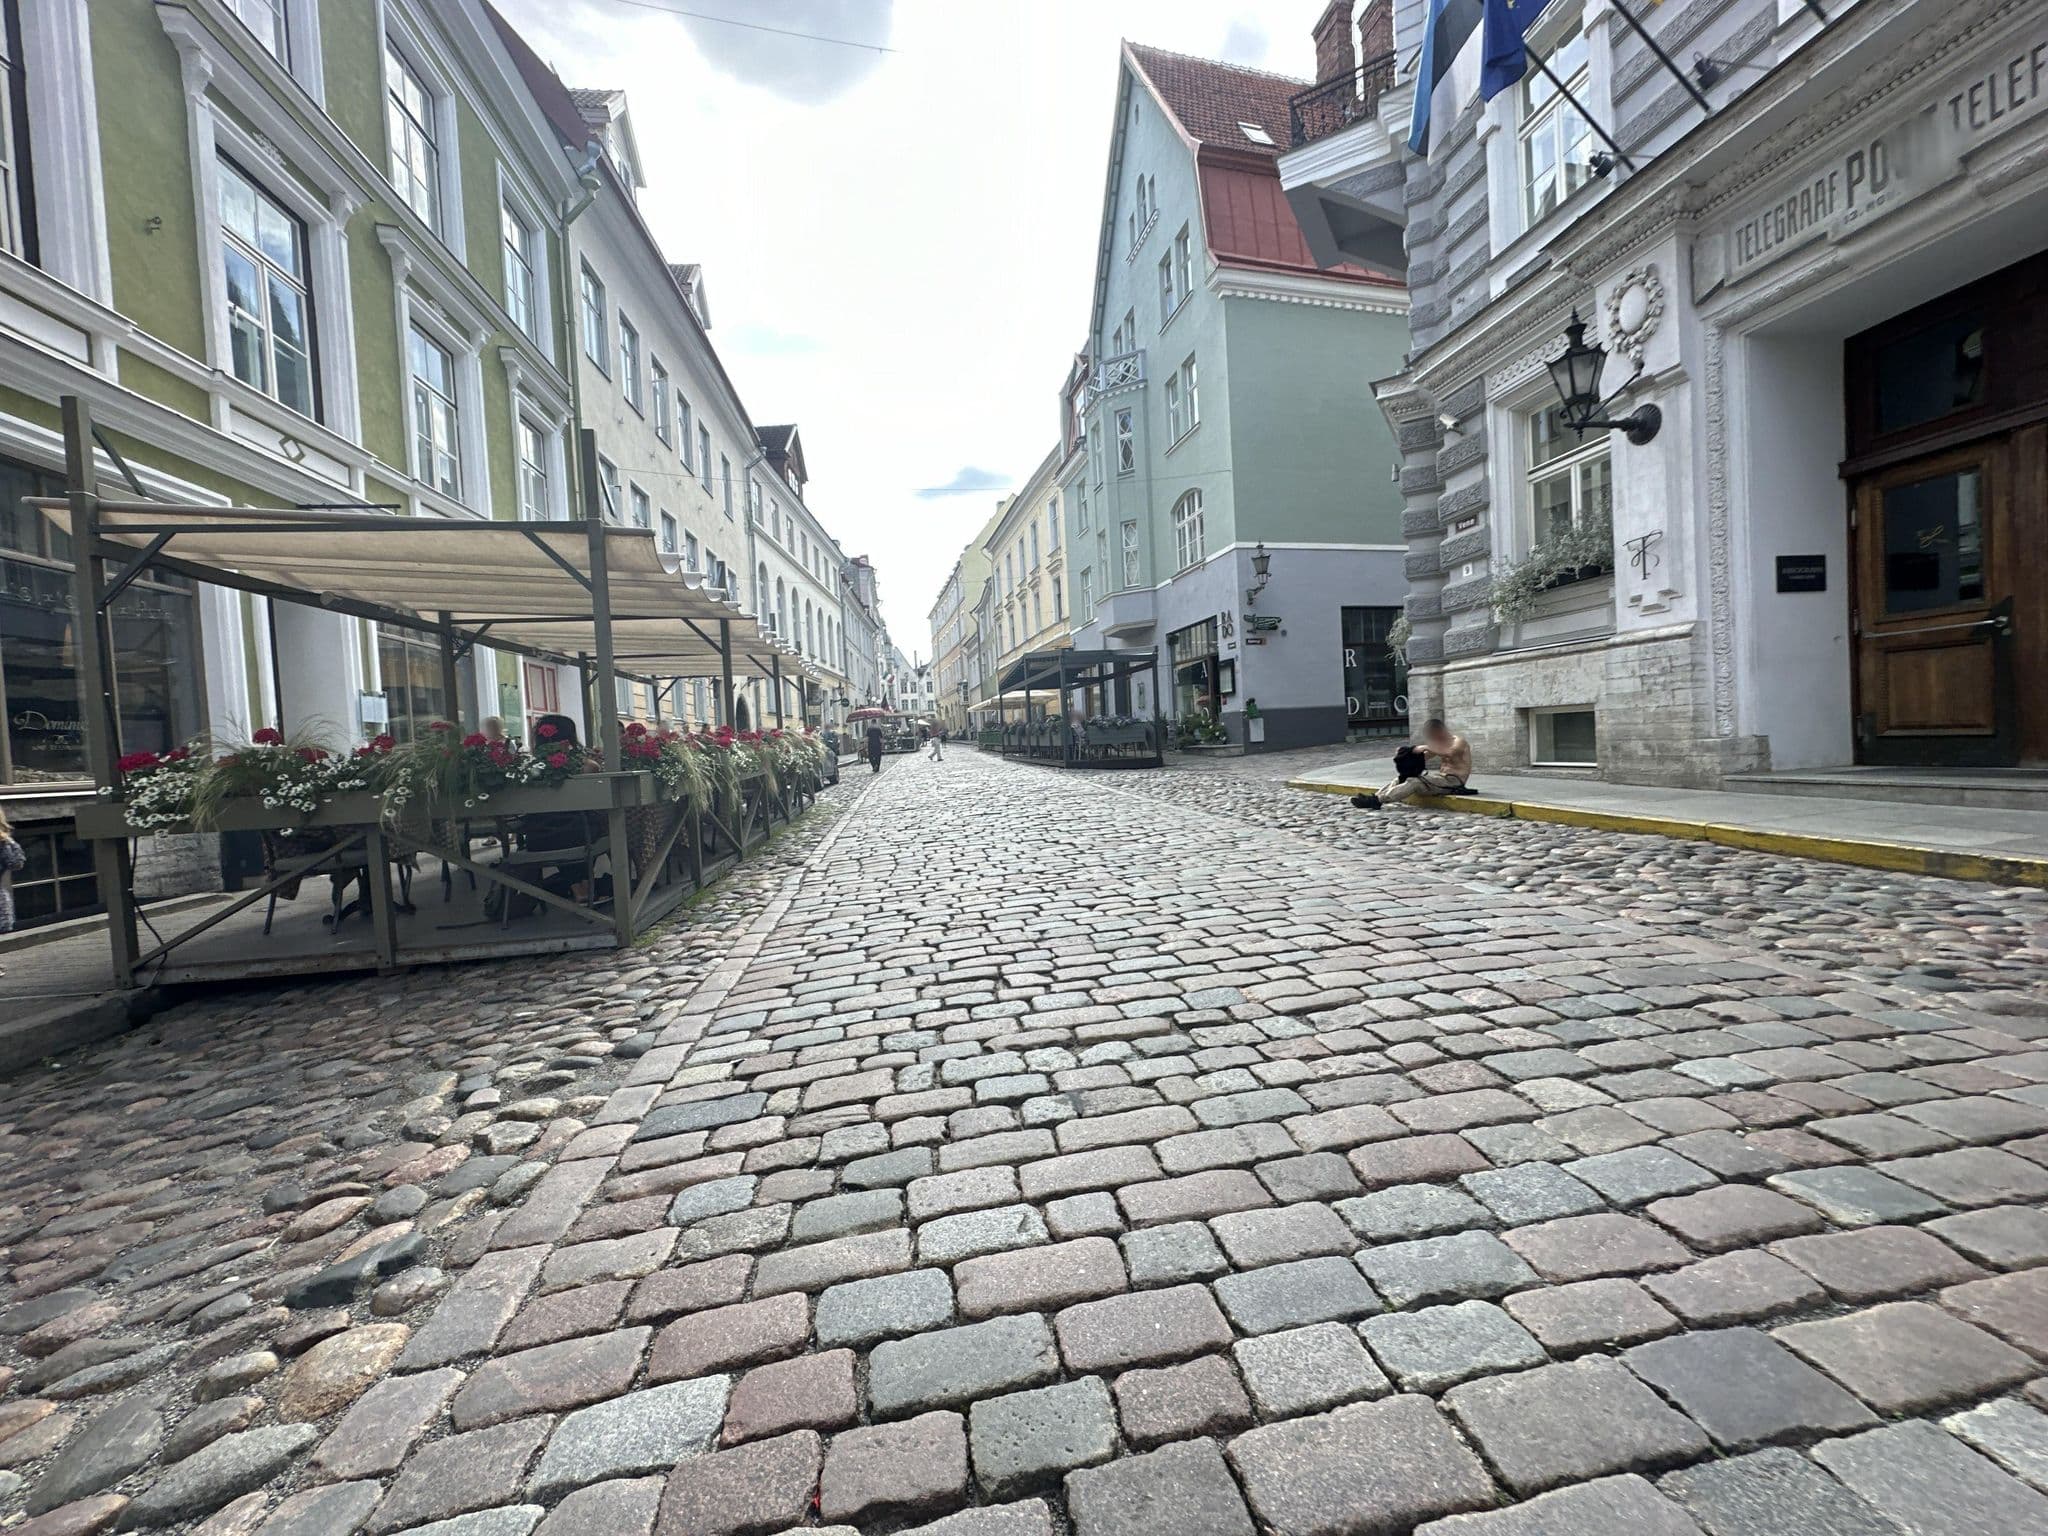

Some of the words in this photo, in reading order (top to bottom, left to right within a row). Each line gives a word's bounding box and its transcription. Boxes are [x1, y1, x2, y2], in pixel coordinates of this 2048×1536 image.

[1735, 170, 1839, 267] TELEGRAAF
[1221, 609, 1234, 625] RA
[1221, 623, 1234, 639] DO
[1344, 648, 1357, 668] R
[1346, 696, 1360, 716] D
